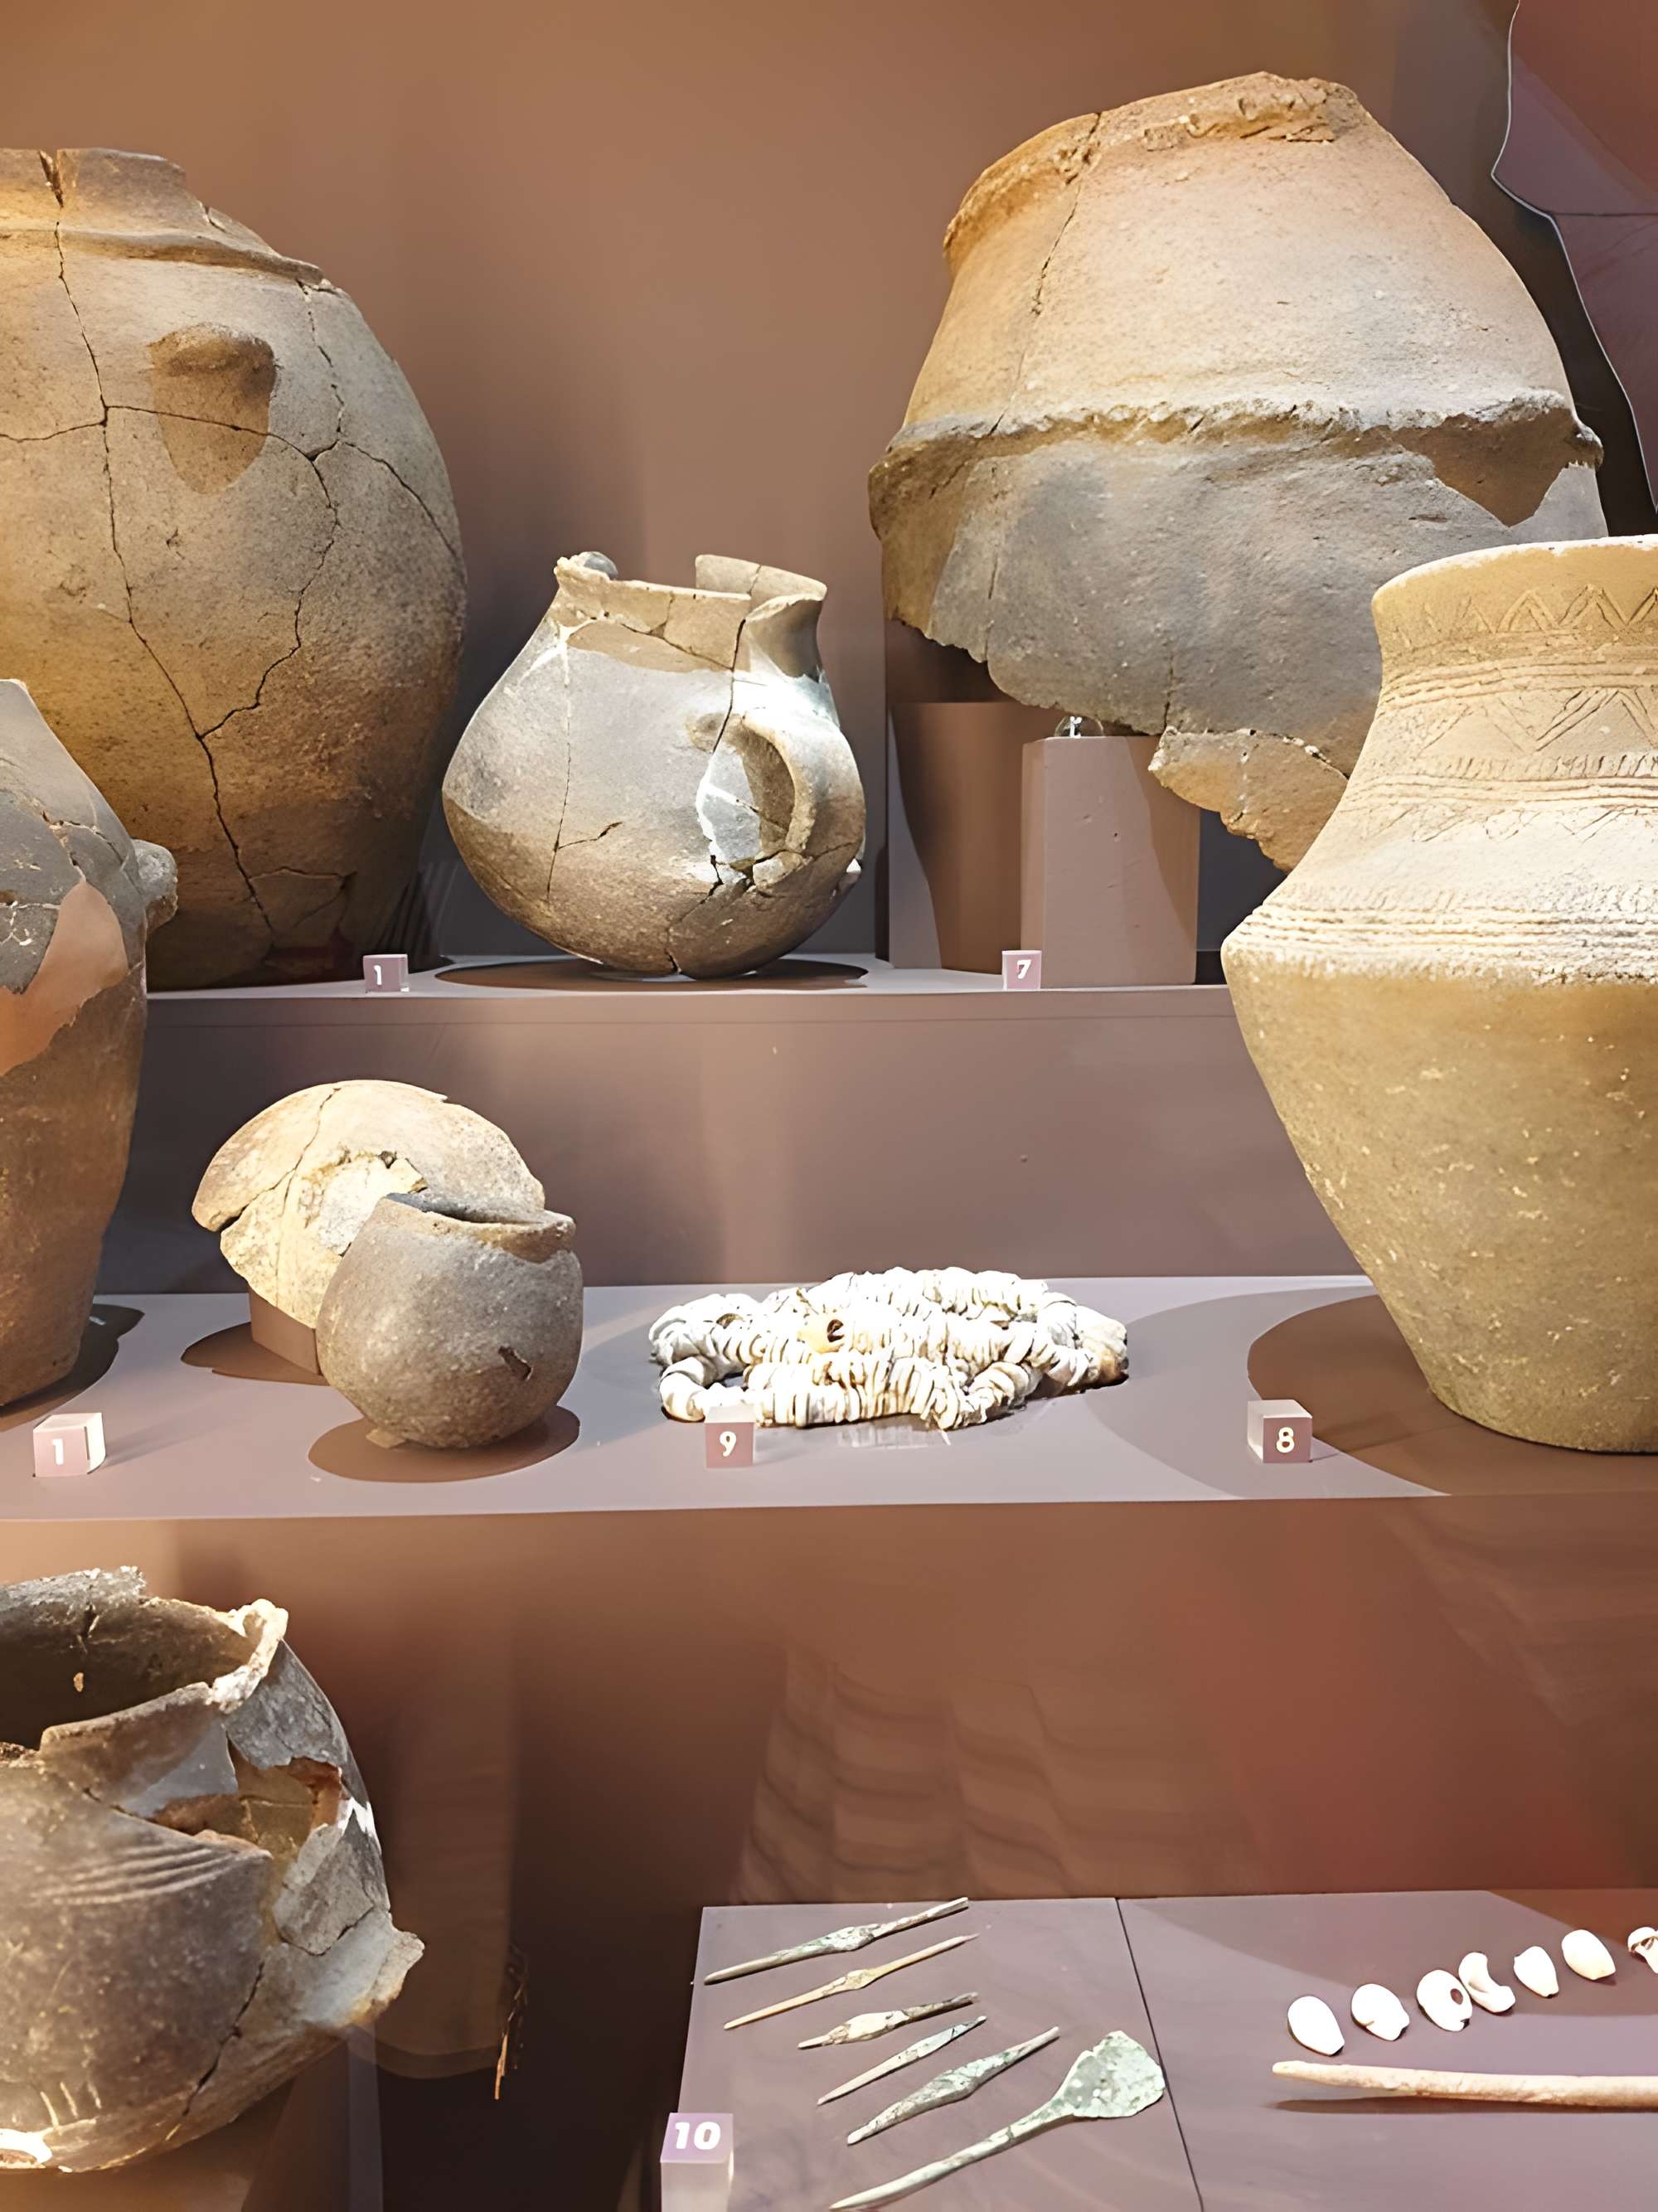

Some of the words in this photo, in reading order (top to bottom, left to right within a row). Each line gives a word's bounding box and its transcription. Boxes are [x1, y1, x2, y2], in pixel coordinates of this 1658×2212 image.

[374, 965, 383, 985] 1
[1016, 959, 1031, 979] 7
[53, 1438, 65, 1465] 1
[720, 1431, 736, 1457] 9
[1276, 1427, 1295, 1453] 8
[675, 2122, 720, 2150] 10
